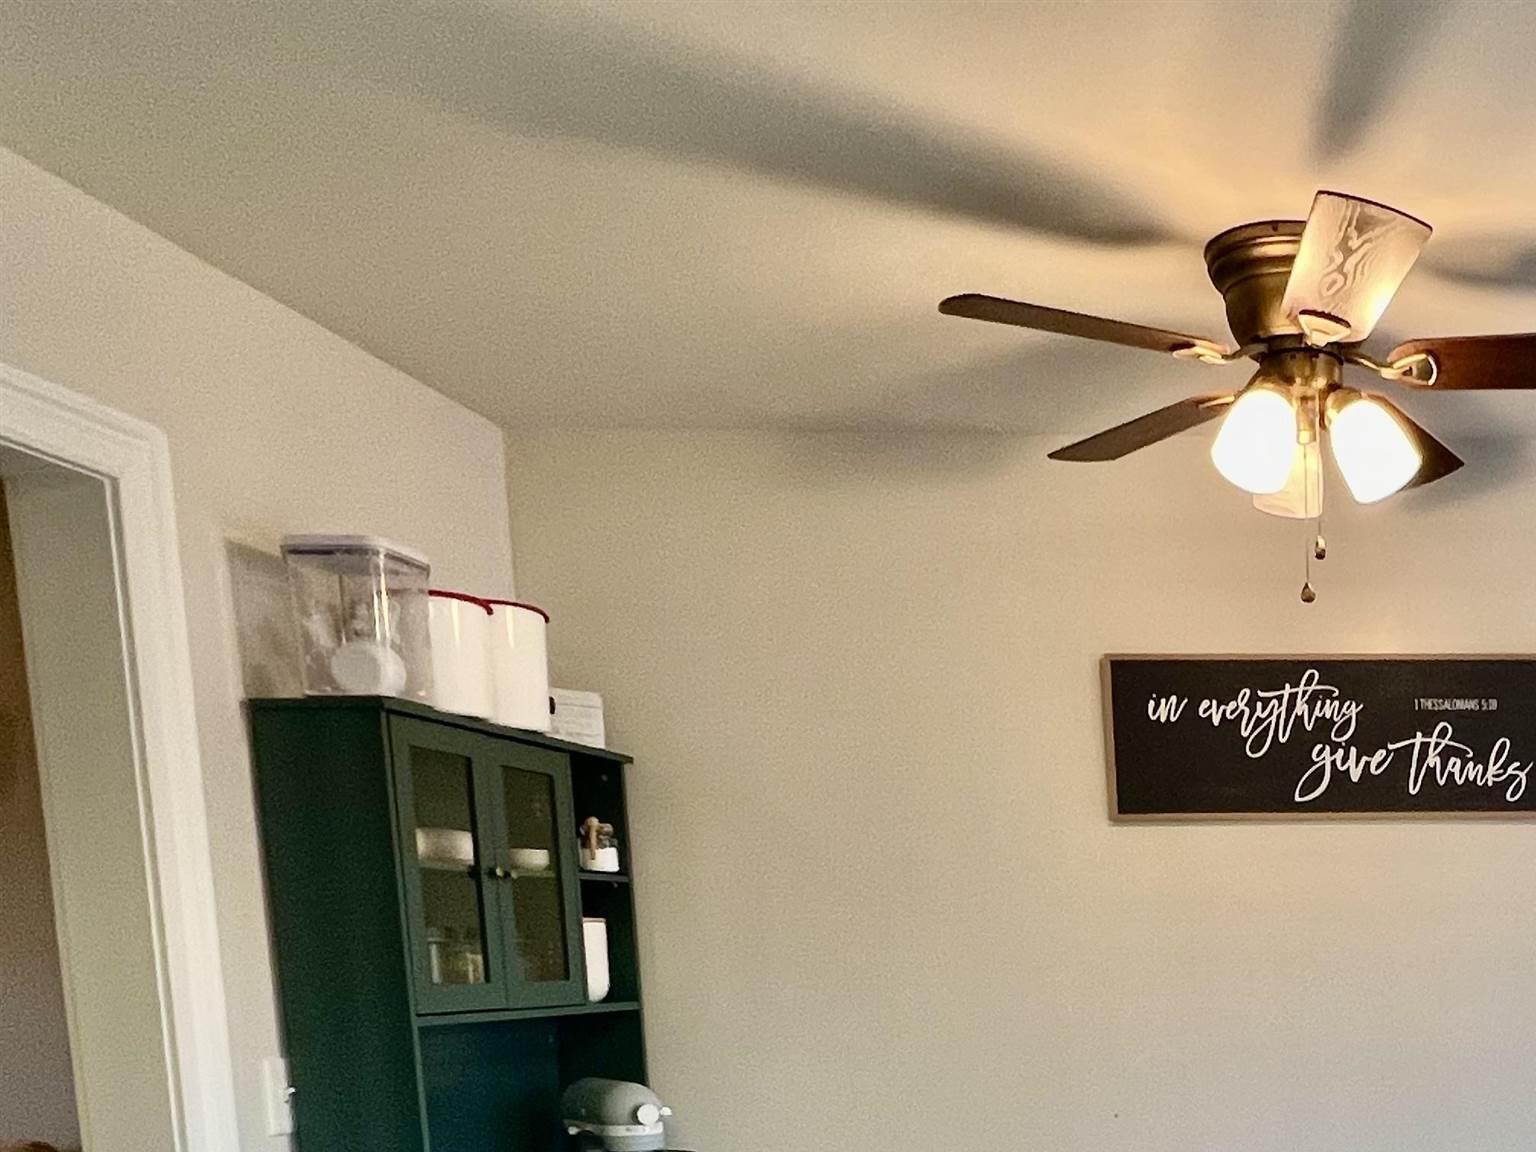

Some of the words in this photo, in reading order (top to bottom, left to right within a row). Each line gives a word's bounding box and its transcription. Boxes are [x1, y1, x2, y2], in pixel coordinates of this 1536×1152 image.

[1147, 693, 1188, 723] in
[1198, 669, 1363, 758] everything
[1294, 739, 1395, 802] give
[1388, 722, 1534, 801] thanks
